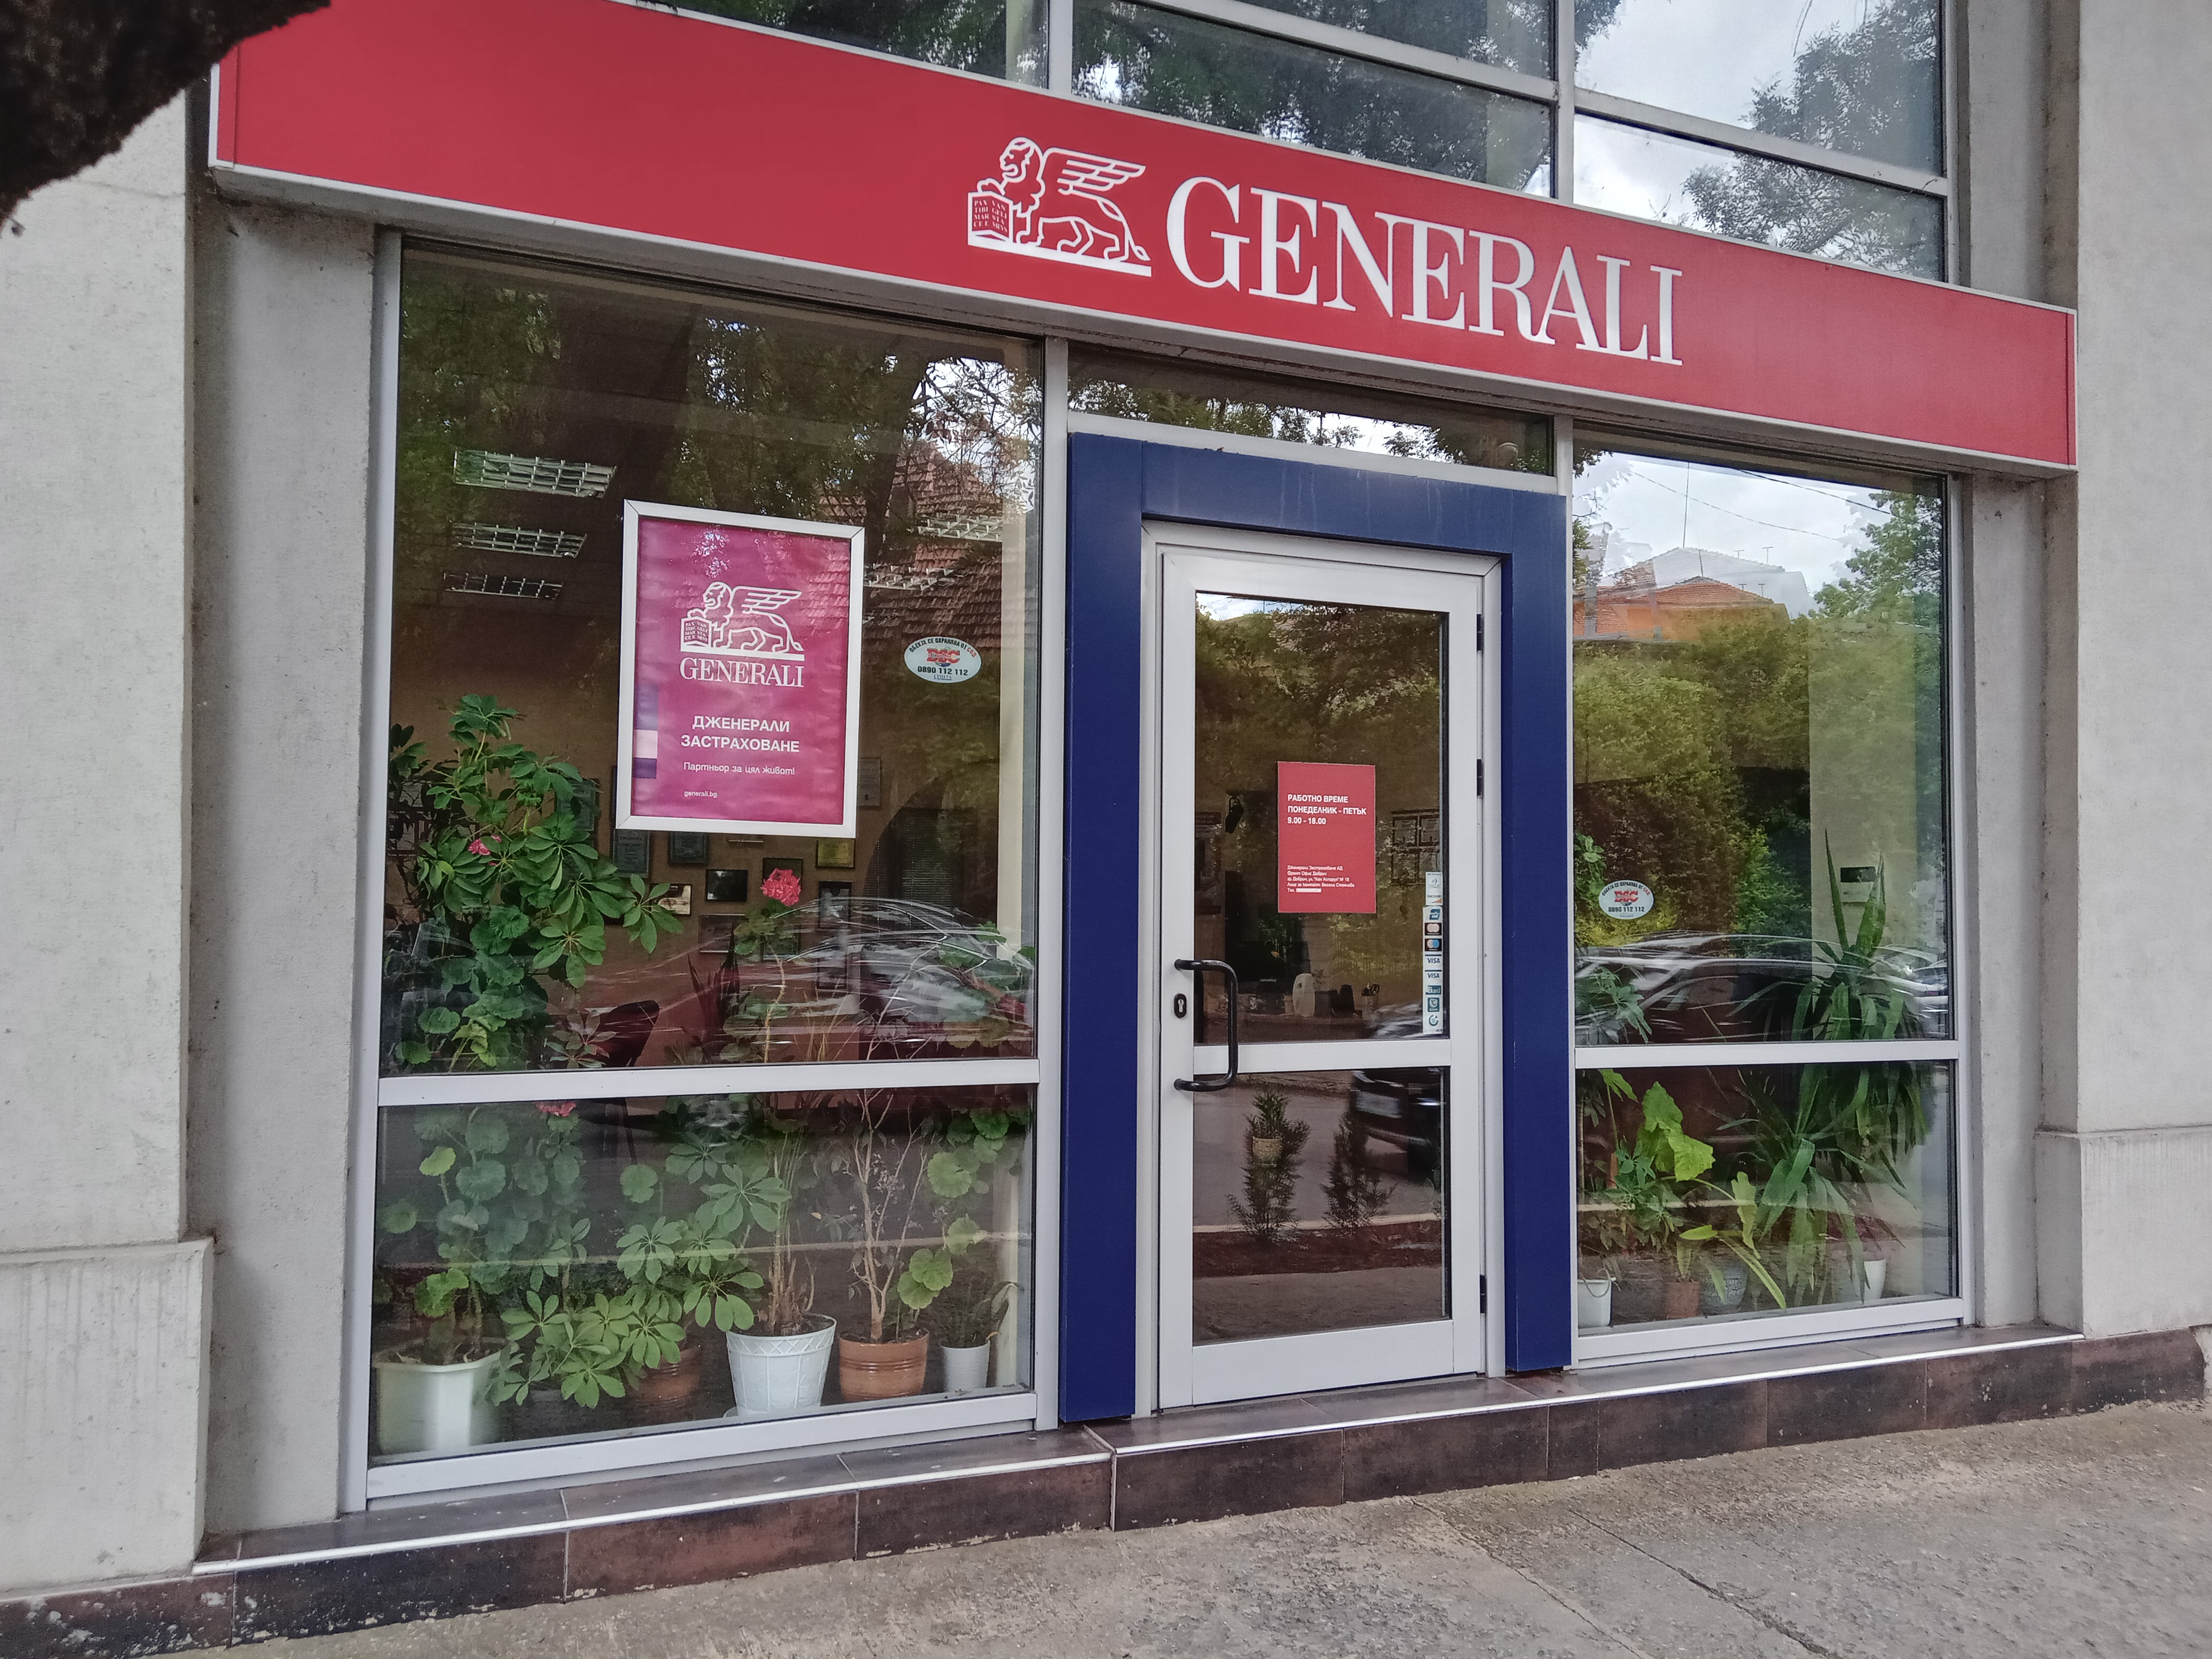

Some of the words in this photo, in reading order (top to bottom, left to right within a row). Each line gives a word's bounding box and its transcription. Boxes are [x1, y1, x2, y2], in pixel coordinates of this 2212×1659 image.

[1166, 176, 1683, 365] GENERALI
[909, 640, 927, 652] ОБЕКТА
[935, 638, 960, 647] ОХРАНЯВА
[967, 647, 977, 658] СОД
[926, 648, 960, 664] DSC
[680, 657, 805, 688] GENERALI
[692, 715, 790, 733] ДЖЕНЕРАЛИ
[681, 734, 800, 752] ЗАСТРАХОВАНЕ
[683, 762, 730, 773] Партньор
[763, 766, 795, 775] живот!
[1287, 794, 1322, 802] РАБОТНО
[1287, 806, 1338, 815] ПОНЕДЕЛНИК
